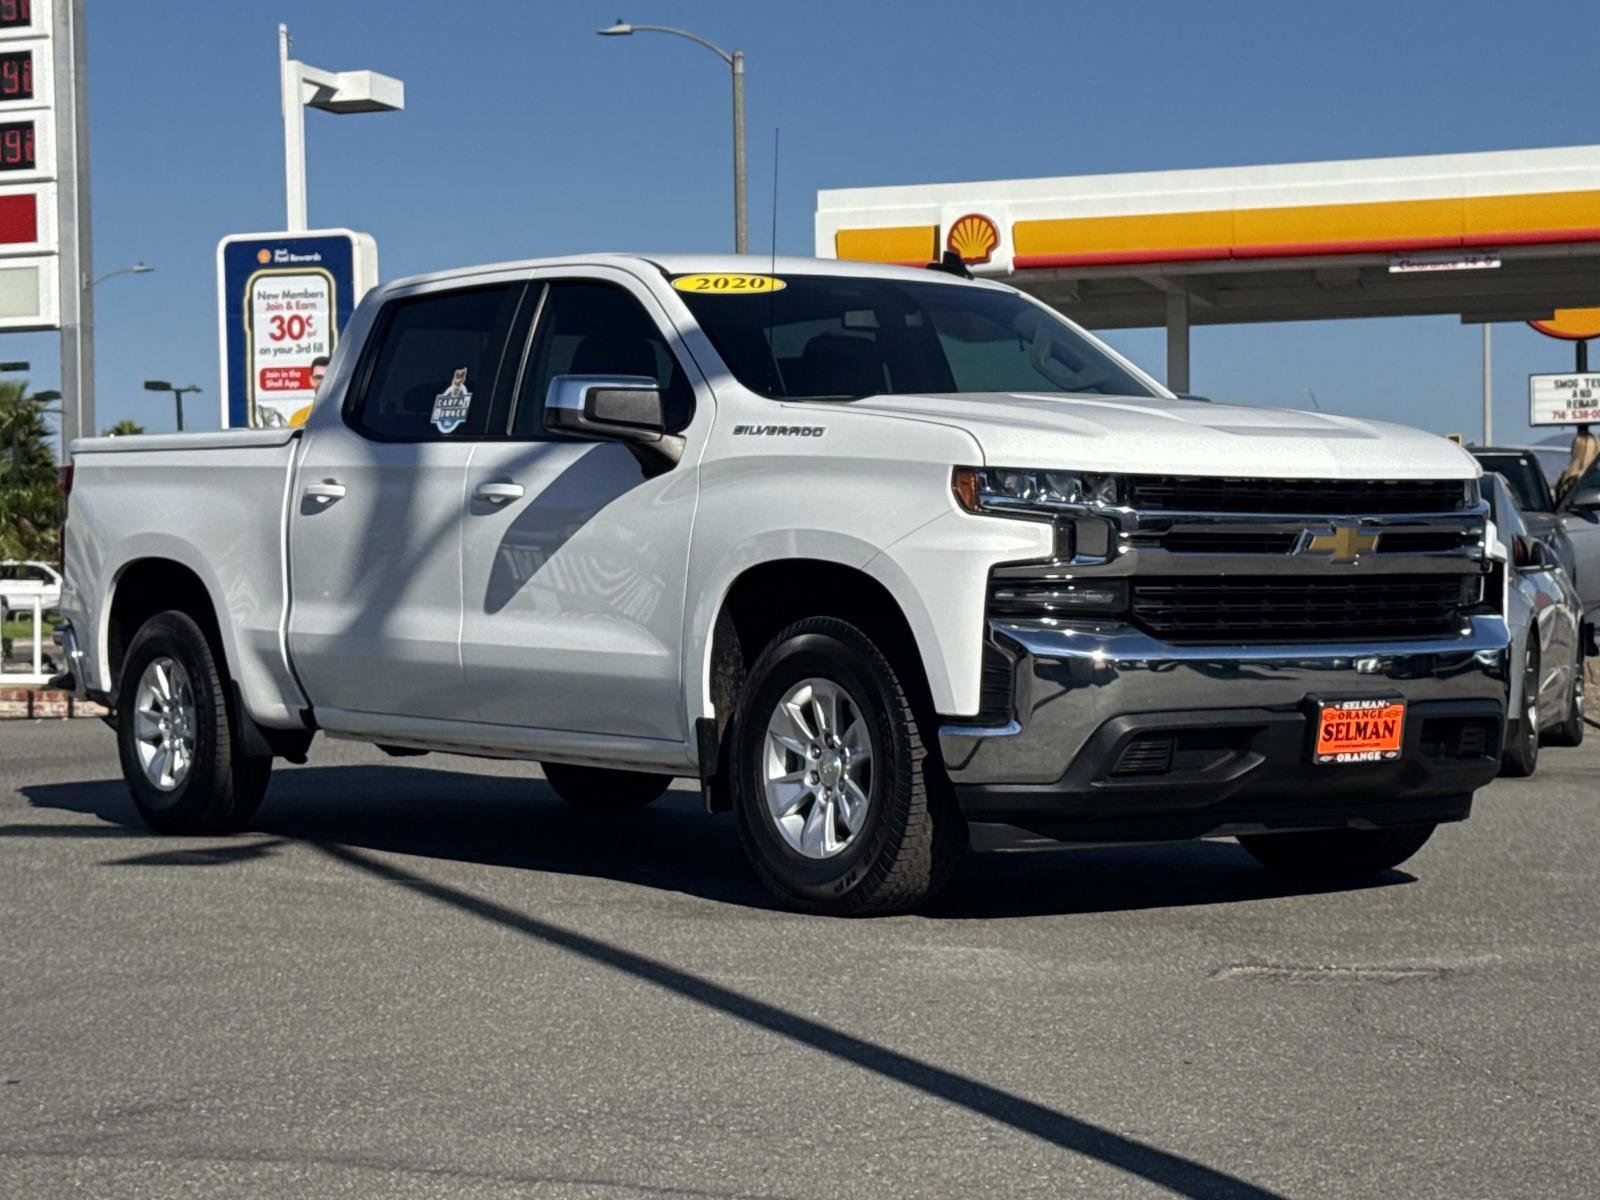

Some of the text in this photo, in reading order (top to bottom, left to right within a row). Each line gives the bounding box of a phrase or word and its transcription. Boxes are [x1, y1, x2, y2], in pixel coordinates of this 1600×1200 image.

[695, 277, 765, 290] 2020
[257, 288, 324, 300] New Members
[265, 300, 317, 310] Join & Earn
[273, 347, 293, 357] your
[295, 343, 311, 354] 3rd
[313, 342, 324, 353] fill
[1553, 379, 1579, 390] SMOG
[733, 425, 826, 437] SILVERADO
[1342, 700, 1386, 710] SELMAN
[1338, 710, 1383, 720] ORANGE
[1322, 720, 1396, 742] SELMAN
[1336, 752, 1381, 763] ORANGE
